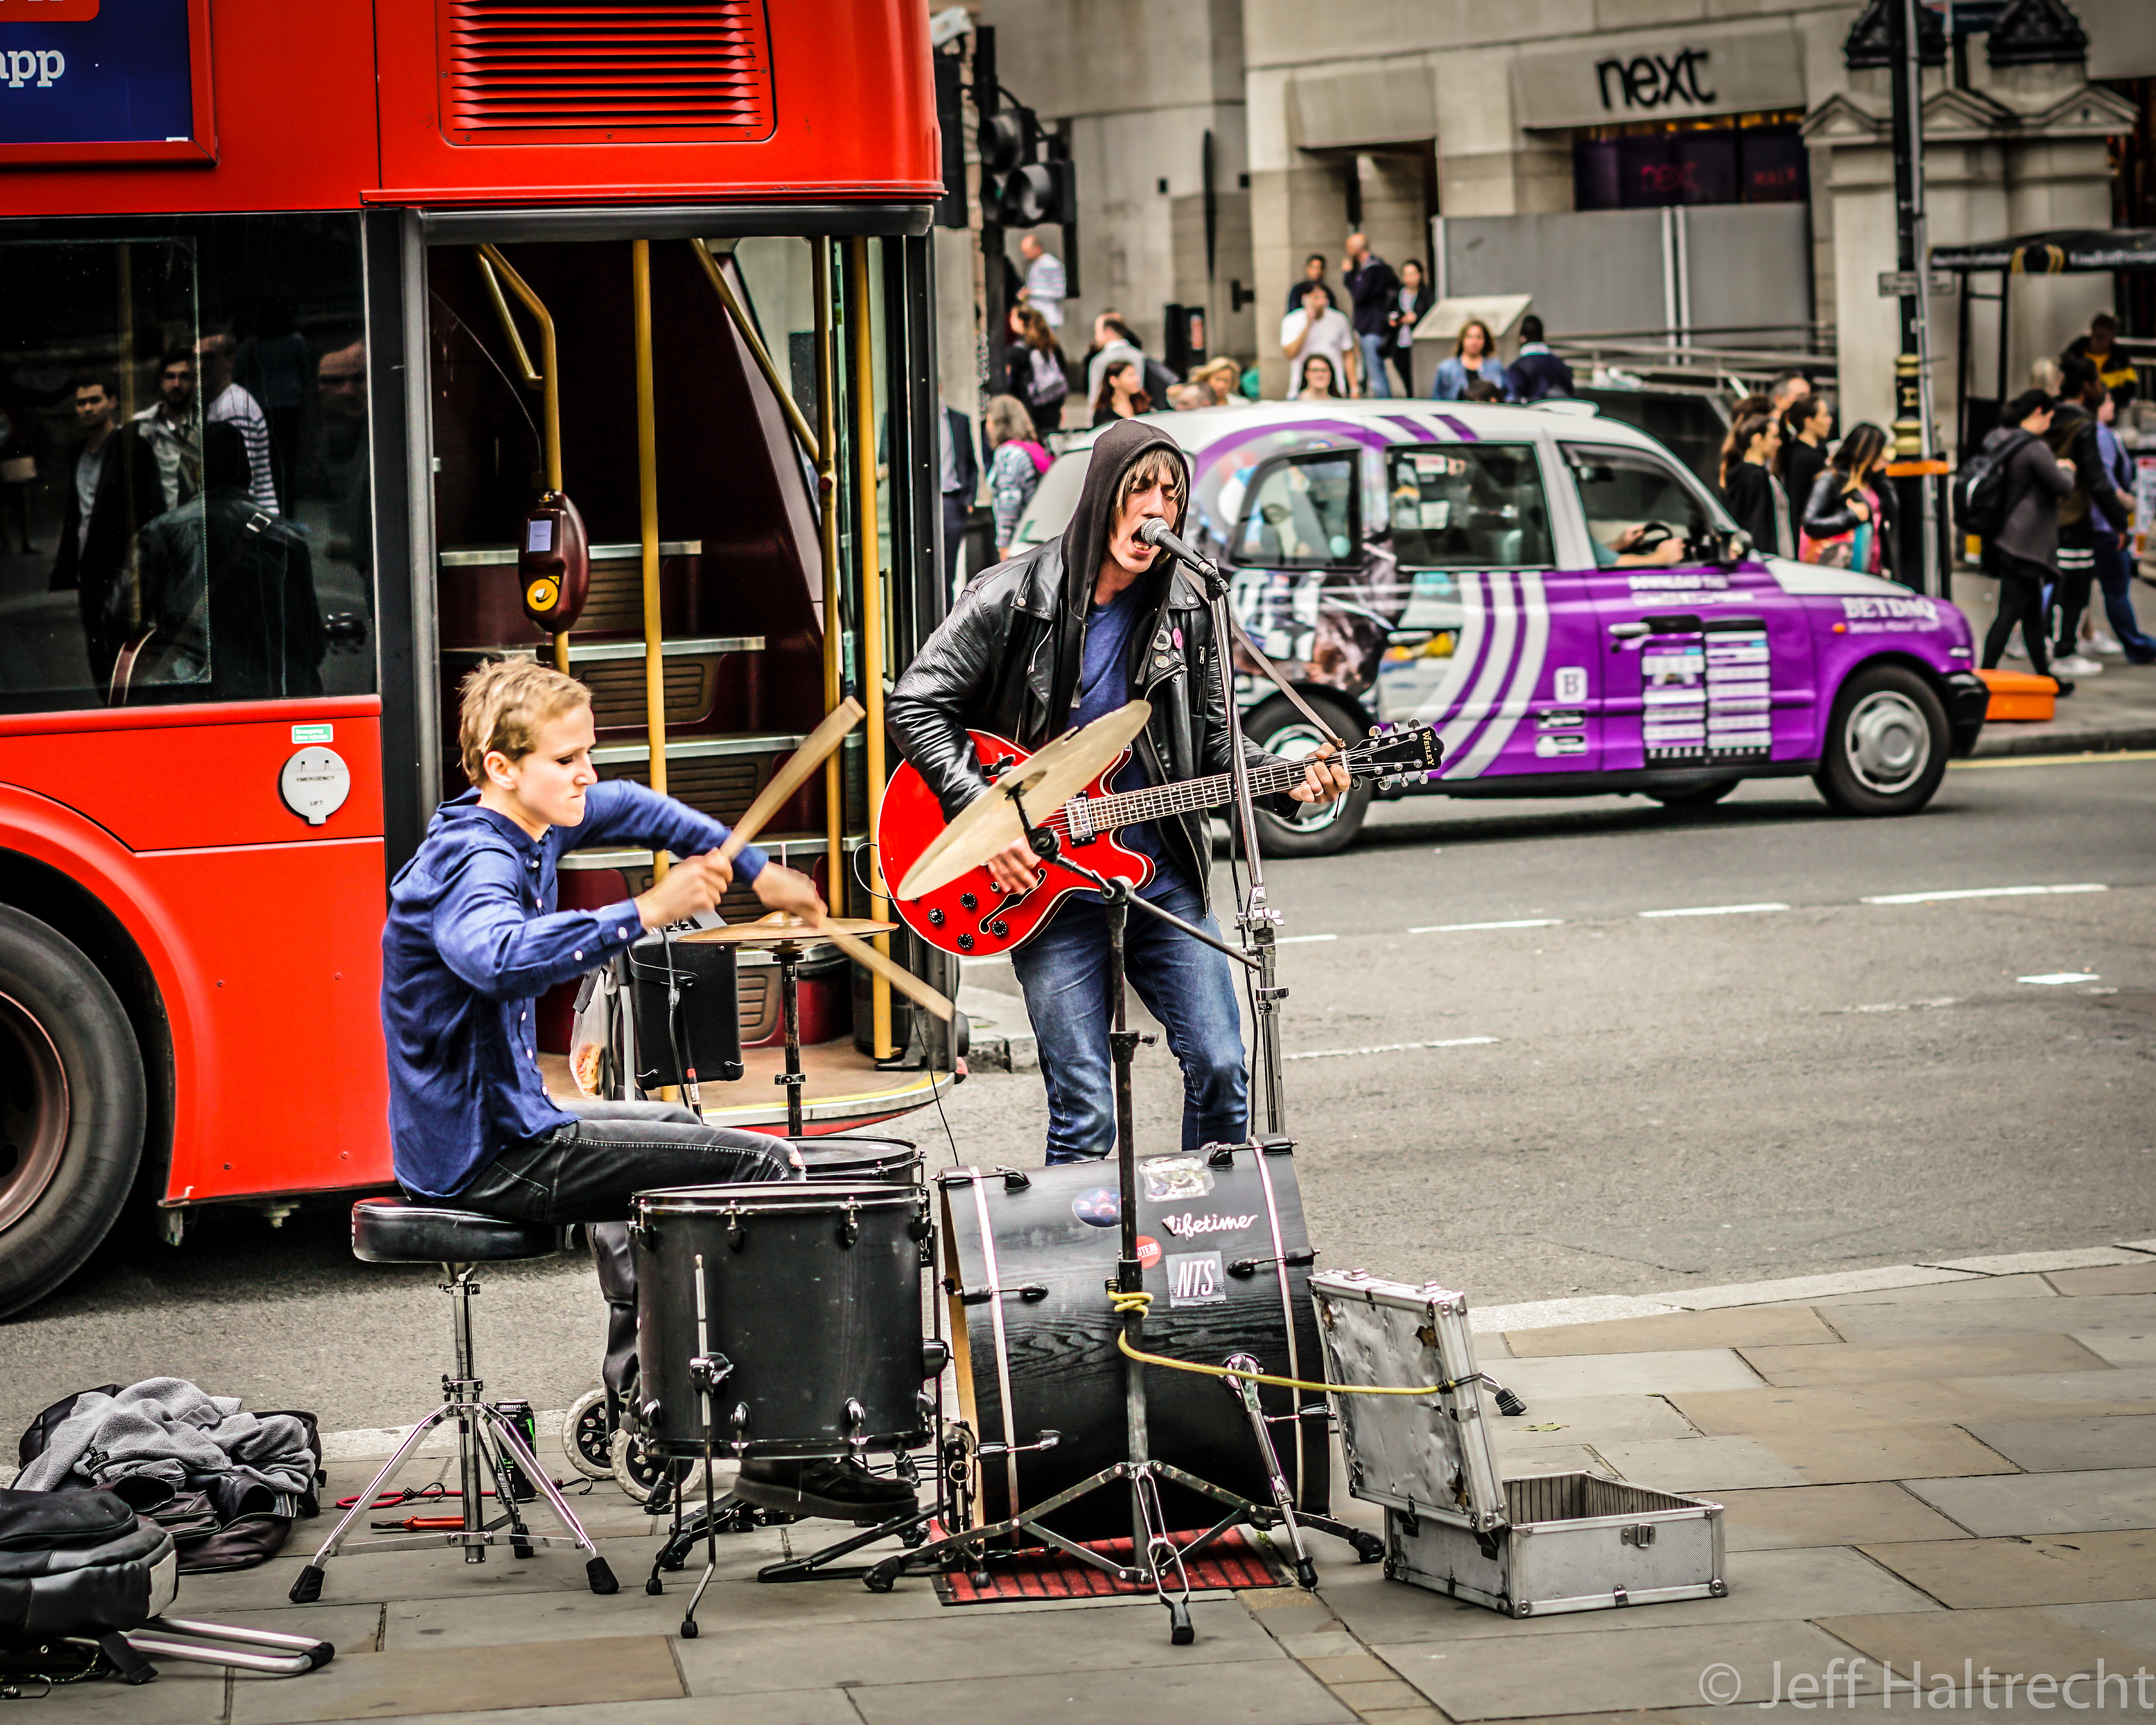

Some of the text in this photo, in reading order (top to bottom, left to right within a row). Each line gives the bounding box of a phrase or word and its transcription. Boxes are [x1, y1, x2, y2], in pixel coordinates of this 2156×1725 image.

[1596, 47, 1716, 111] next
[1422, 730, 1434, 766] WESLEY
[1176, 1259, 1216, 1297] NTS
